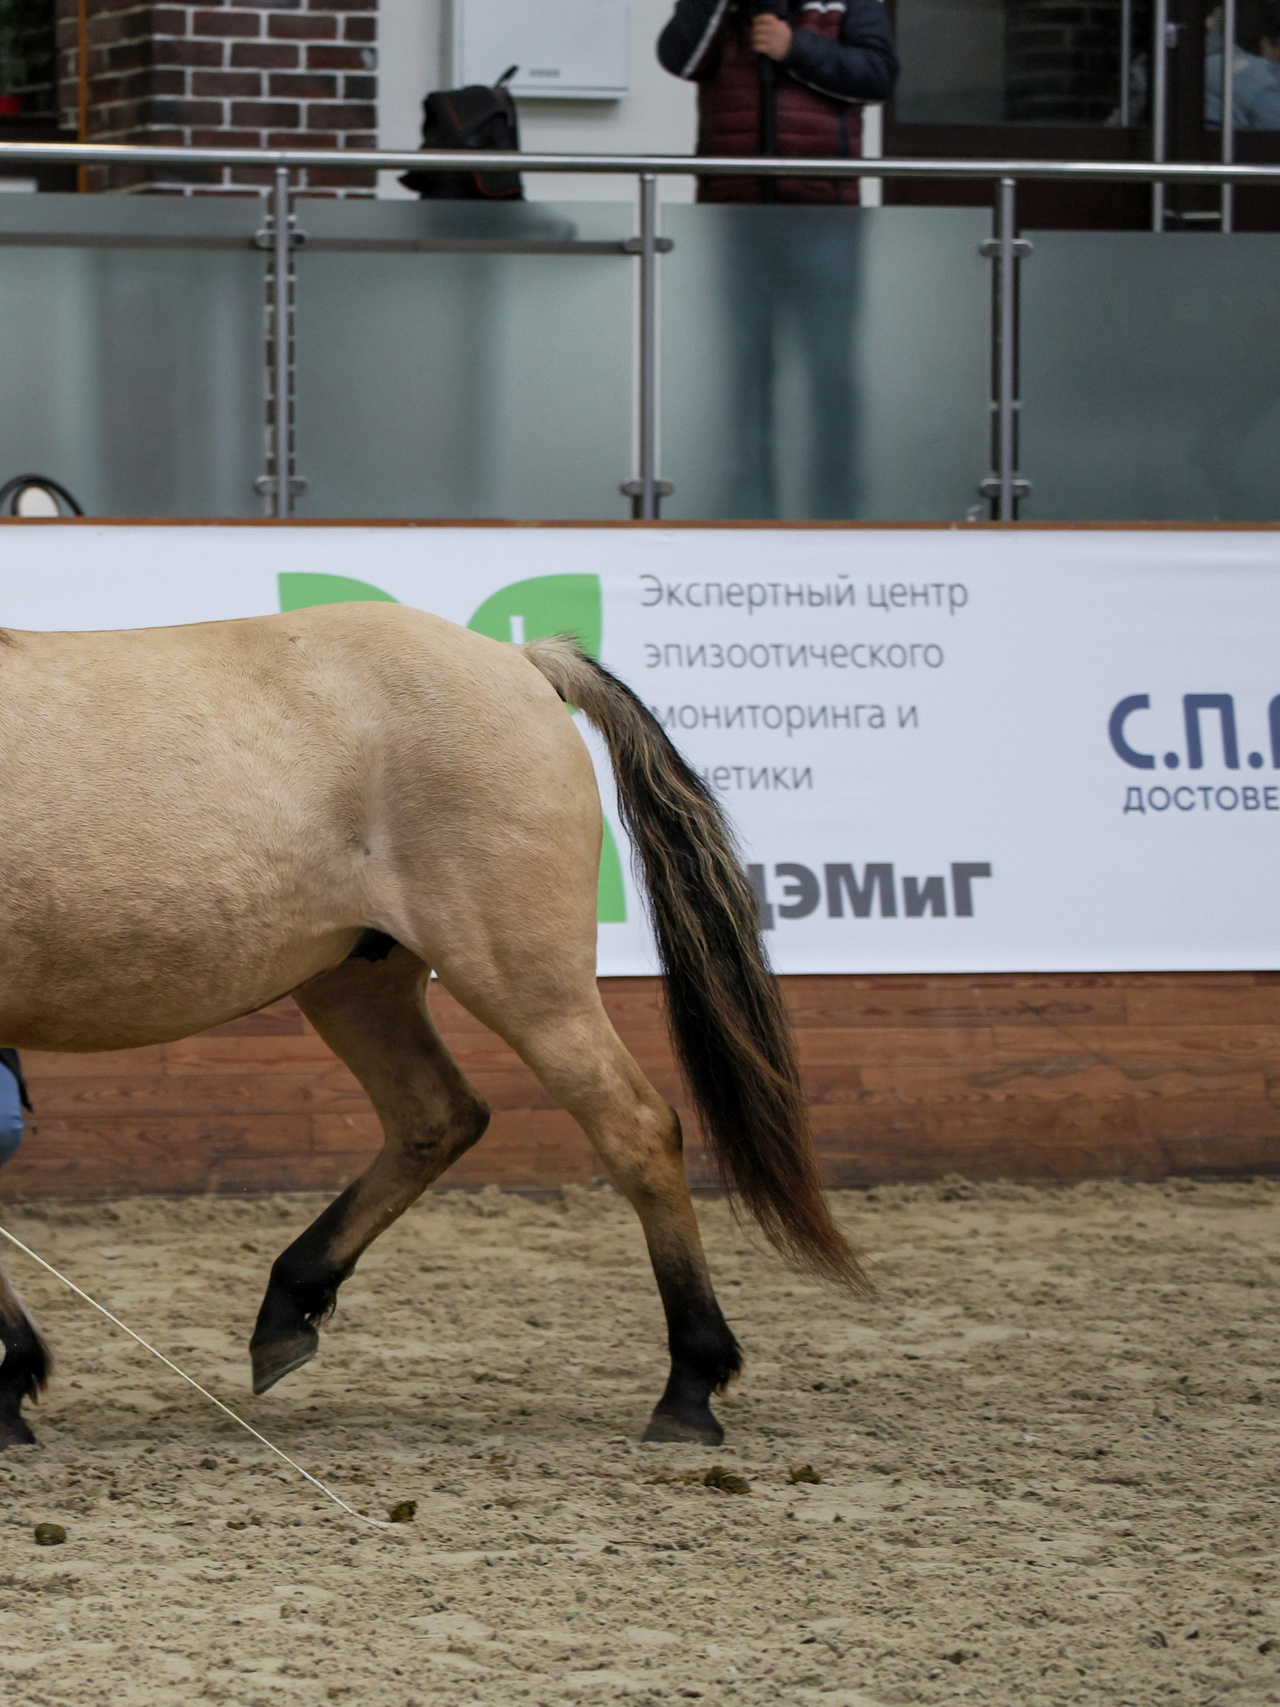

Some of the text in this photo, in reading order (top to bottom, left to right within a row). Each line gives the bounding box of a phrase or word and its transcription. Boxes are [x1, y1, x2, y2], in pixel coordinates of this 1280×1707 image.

[638, 574, 969, 615] Экспертный центр
[644, 643, 944, 668] эпизоотического
[651, 703, 920, 738] мониторинга и
[1108, 693, 1280, 770] С.П.
